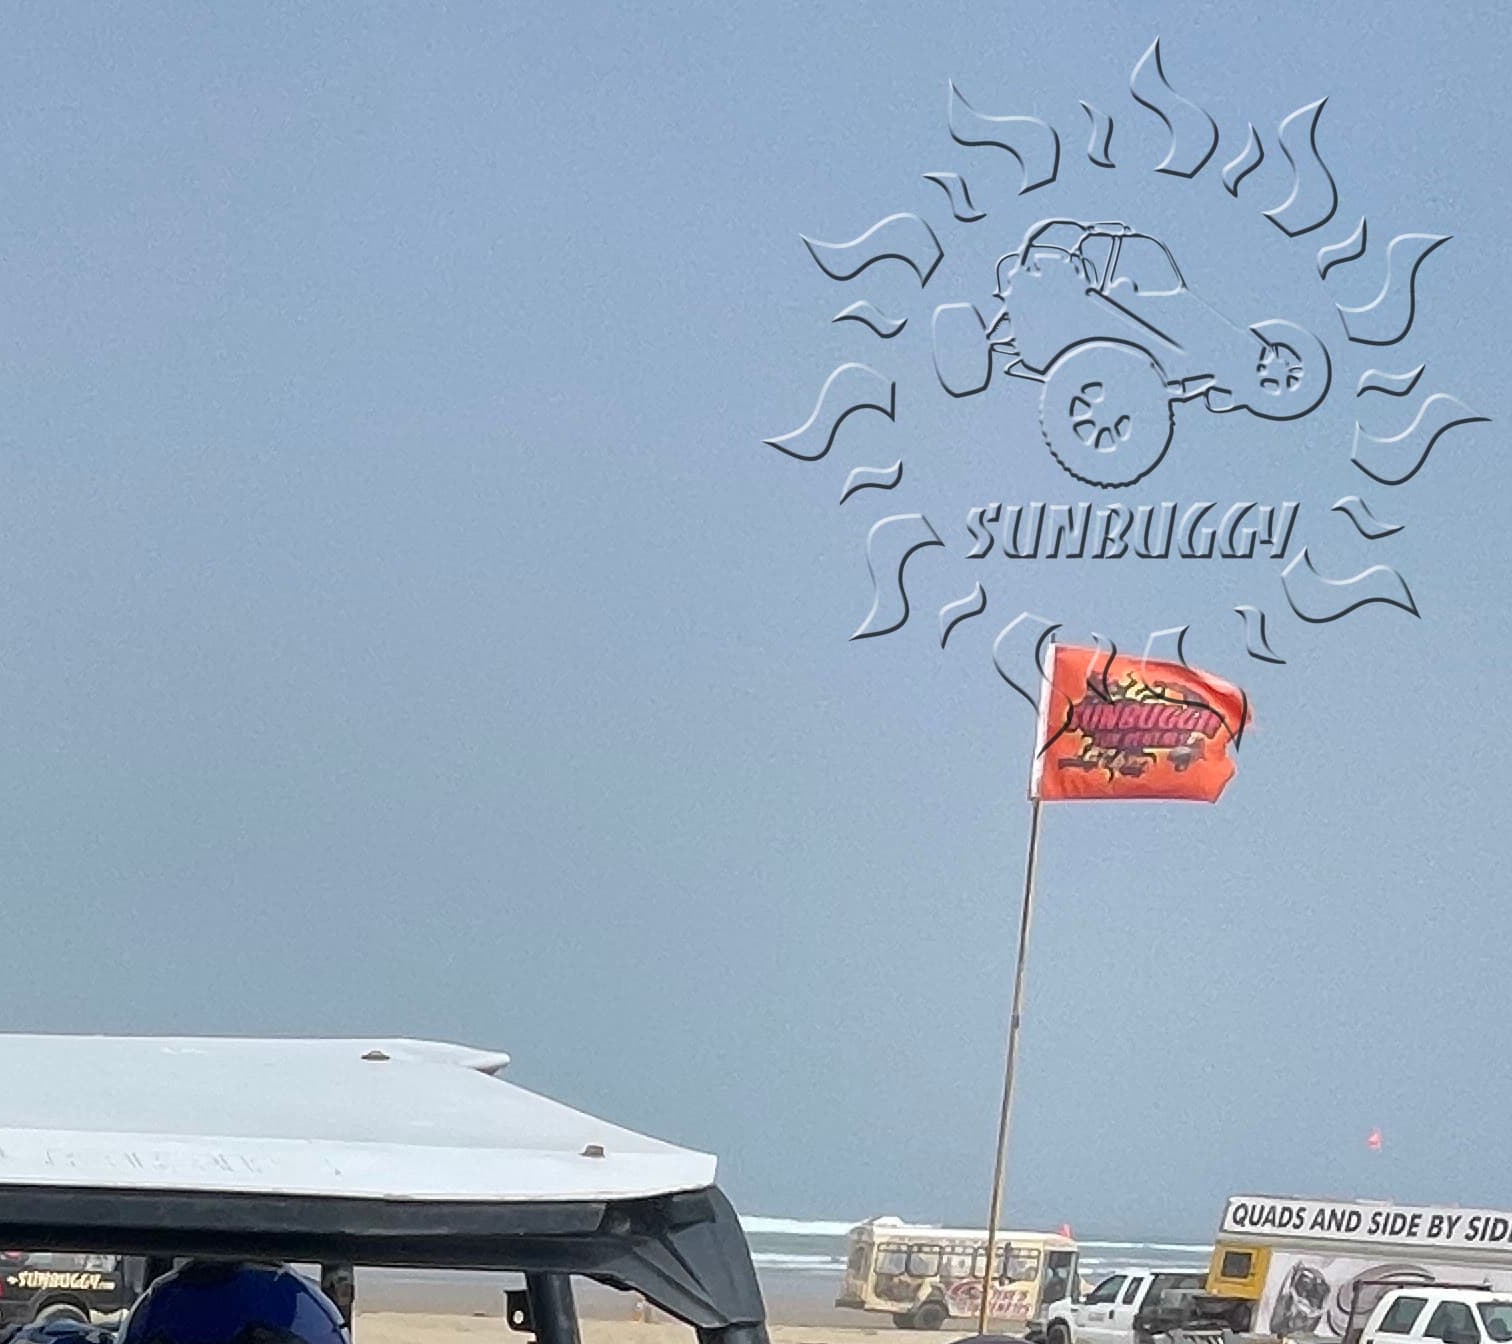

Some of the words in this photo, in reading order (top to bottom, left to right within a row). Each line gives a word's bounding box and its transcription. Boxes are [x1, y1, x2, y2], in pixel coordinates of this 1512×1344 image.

[1231, 1202, 1307, 1230] QUADS
[1309, 1207, 1362, 1233] AND
[1367, 1211, 1422, 1237] SIDE
[1426, 1214, 1462, 1240] BY
[1463, 1216, 1512, 1243] SID
